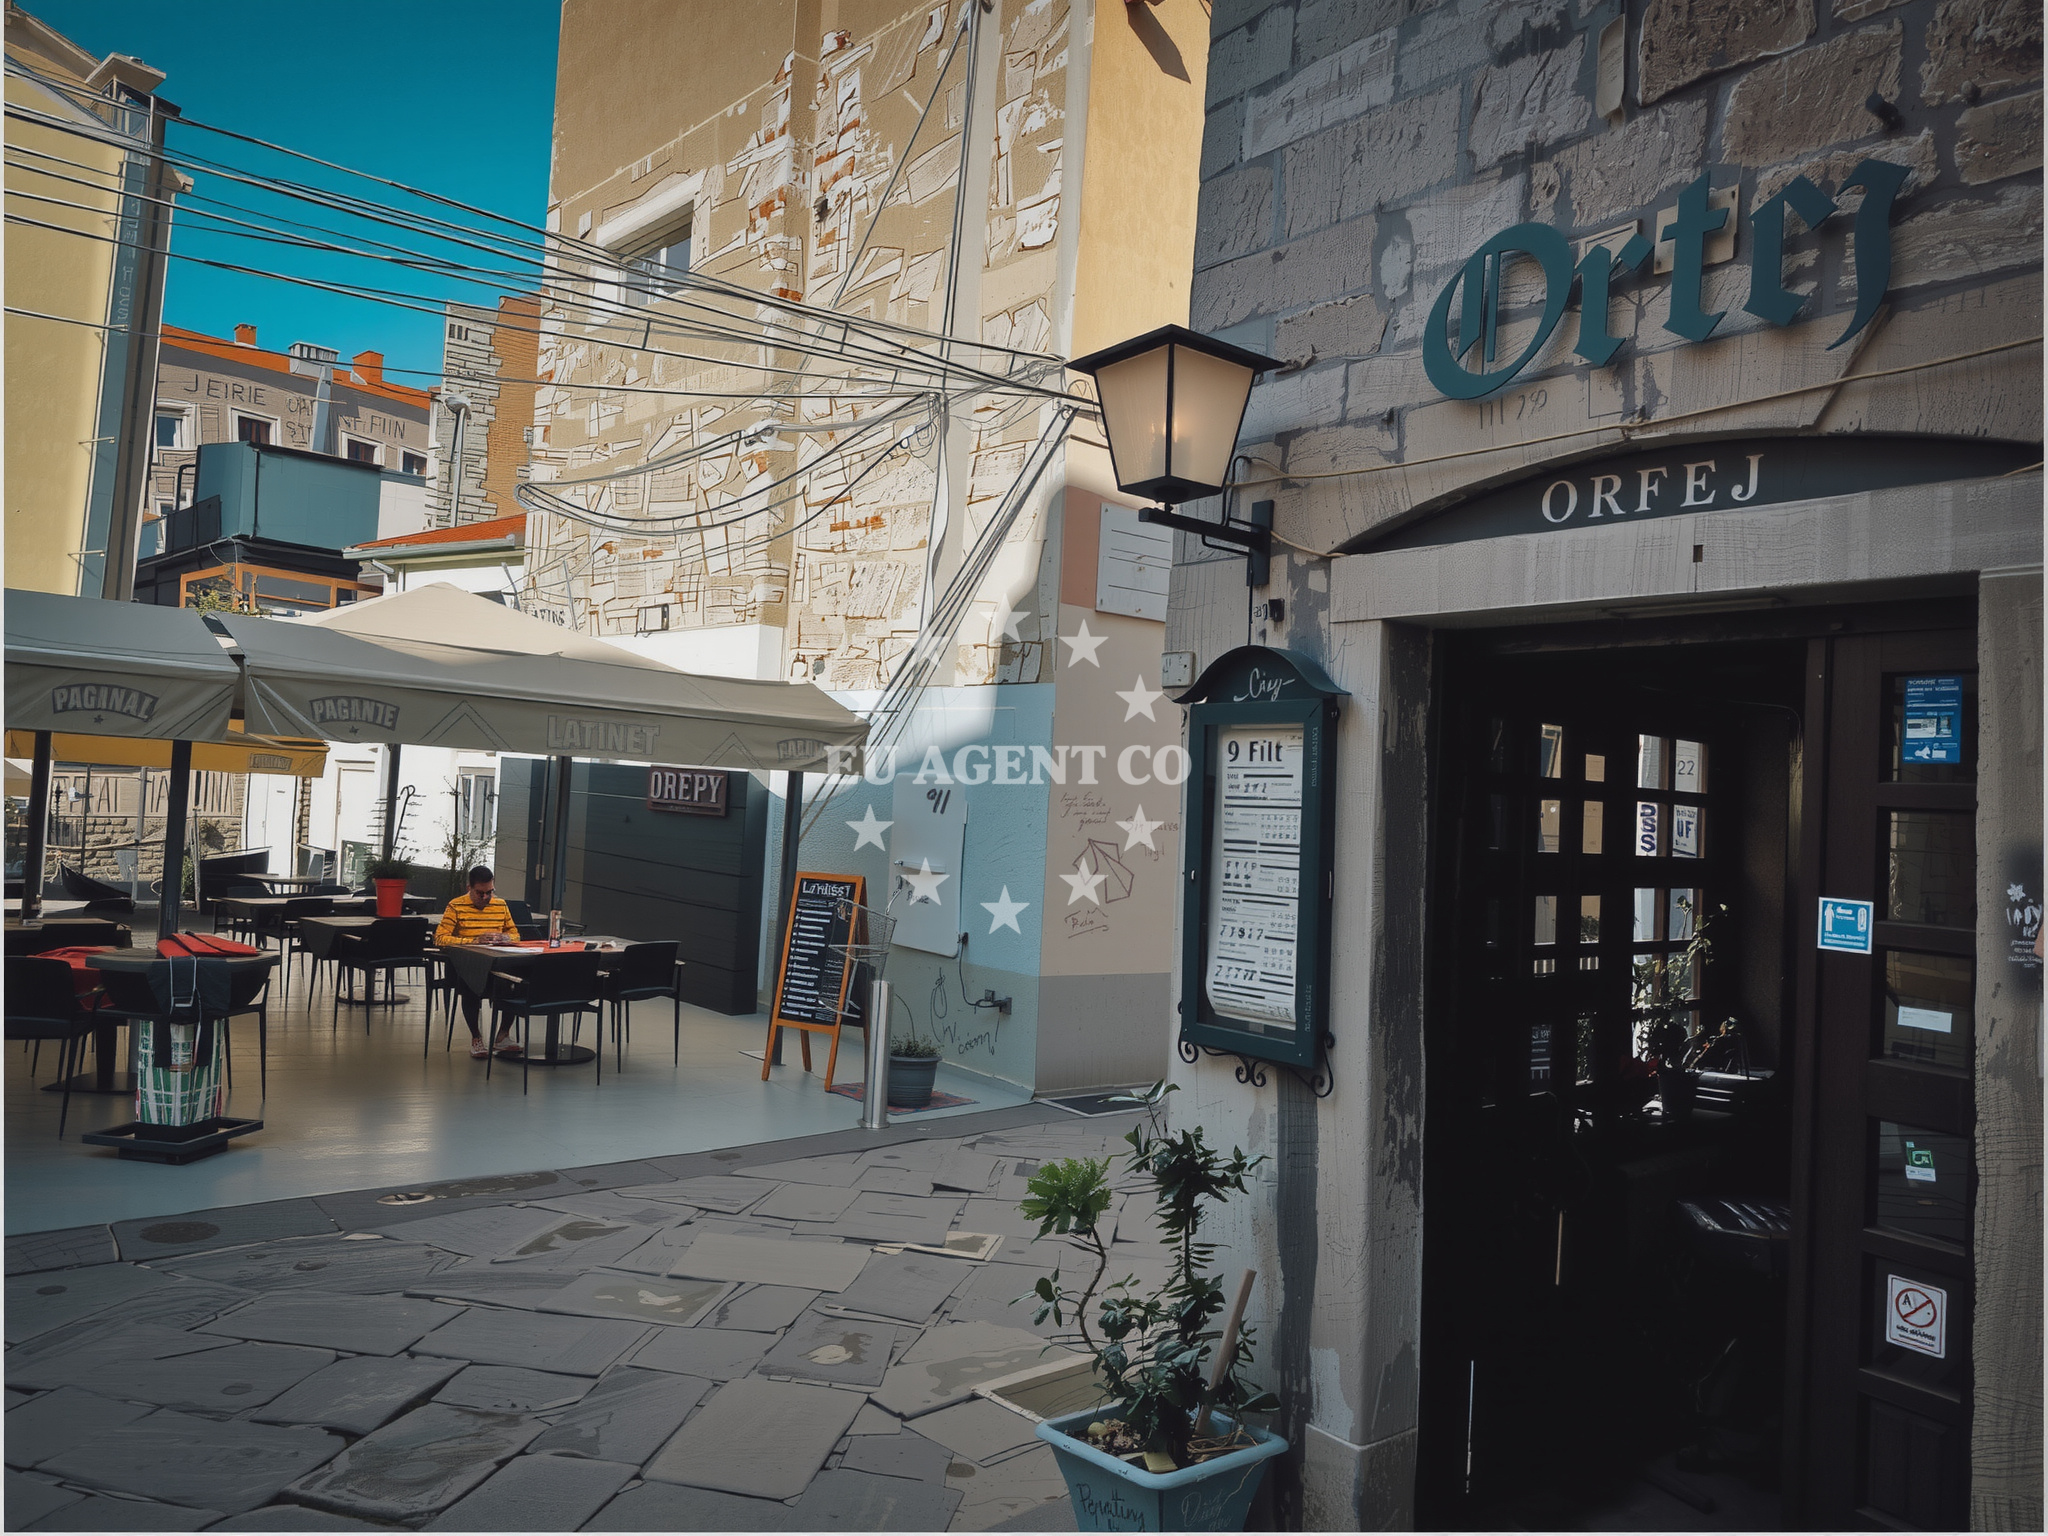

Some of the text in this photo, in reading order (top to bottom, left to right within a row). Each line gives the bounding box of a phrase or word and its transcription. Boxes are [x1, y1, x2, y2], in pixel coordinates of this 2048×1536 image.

[1540, 453, 1765, 524] ORFEJ
[547, 715, 661, 756] LATINET
[1227, 740, 1240, 763] 9
[1677, 760, 1695, 775] 22
[650, 771, 724, 803] OREPY
